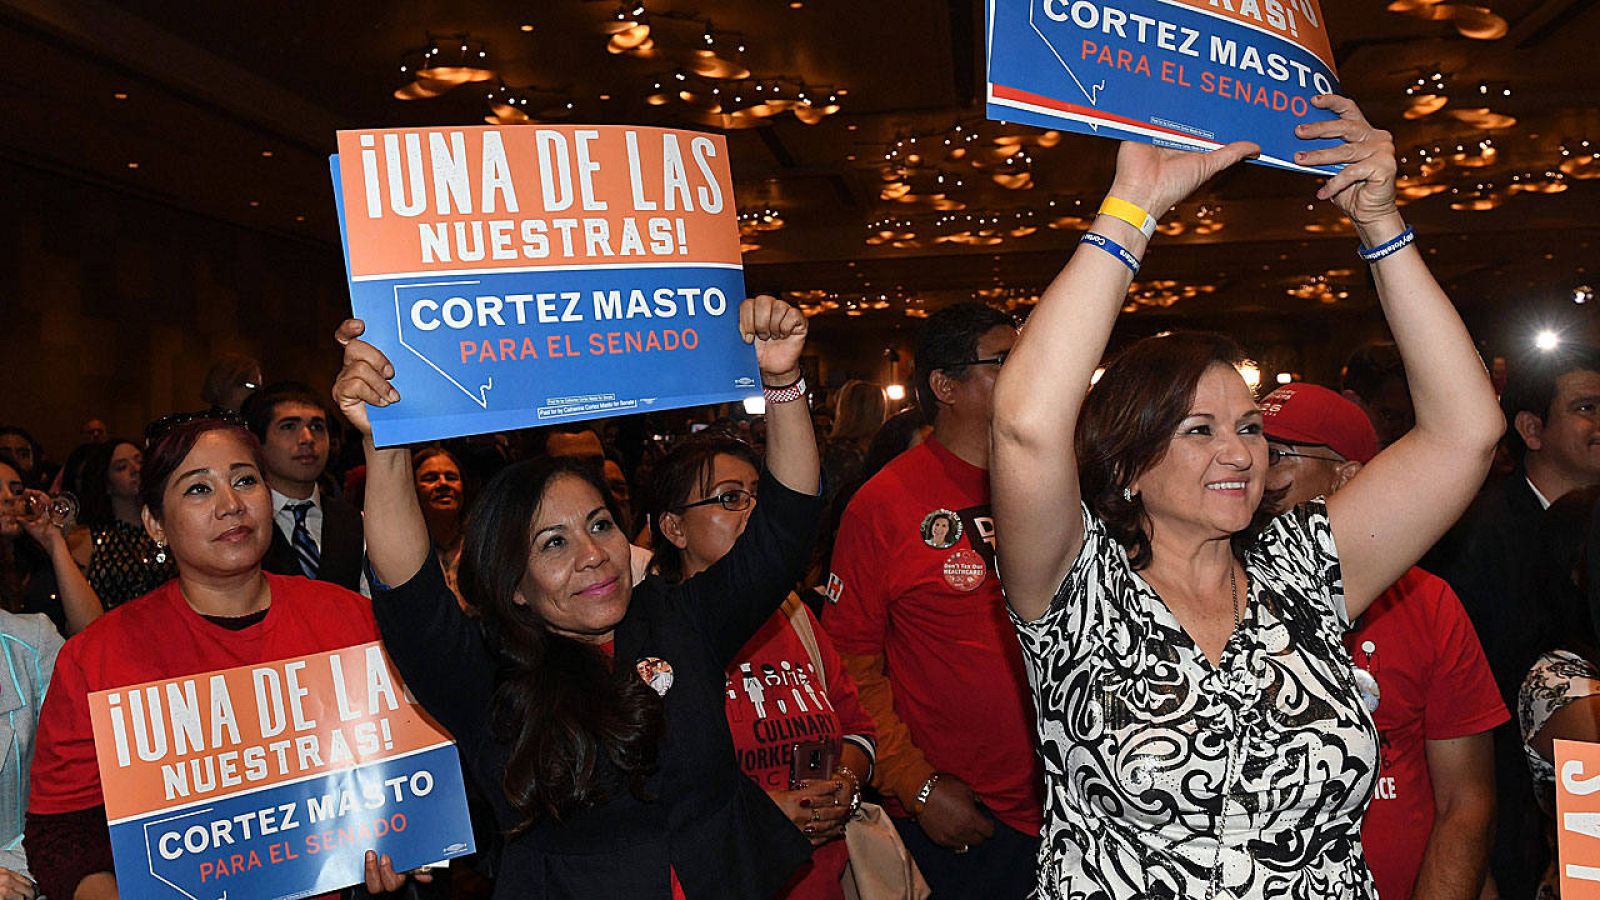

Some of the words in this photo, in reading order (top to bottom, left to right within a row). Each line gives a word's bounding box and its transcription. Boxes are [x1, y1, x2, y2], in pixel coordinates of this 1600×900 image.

[1043, 0, 1200, 57] CORTEZ
[1210, 35, 1334, 96] MASTO
[1081, 39, 1151, 78] PARA
[1161, 60, 1191, 87] EL
[1200, 71, 1308, 118] SENADO
[360, 130, 520, 218] ¡UNA
[535, 129, 608, 213] DE
[624, 130, 724, 215] LAS
[418, 216, 688, 264] NUESTRAS!
[410, 292, 584, 331] CORTEZ
[592, 287, 727, 320] MASTO
[459, 338, 538, 364] PARA
[547, 335, 581, 358] EL
[589, 328, 699, 355] SENADO
[107, 674, 242, 768] ¡UNA
[251, 660, 317, 739] DE
[329, 645, 420, 722] LA
[753, 713, 837, 744] CULINARY
[161, 717, 394, 801] NUESTRAS!
[738, 743, 791, 771] ORKE
[158, 801, 300, 861] CORTEZ
[307, 770, 435, 824] MASTO
[199, 849, 263, 883] PARA
[269, 841, 299, 865] EL
[304, 813, 408, 855] SENADO
